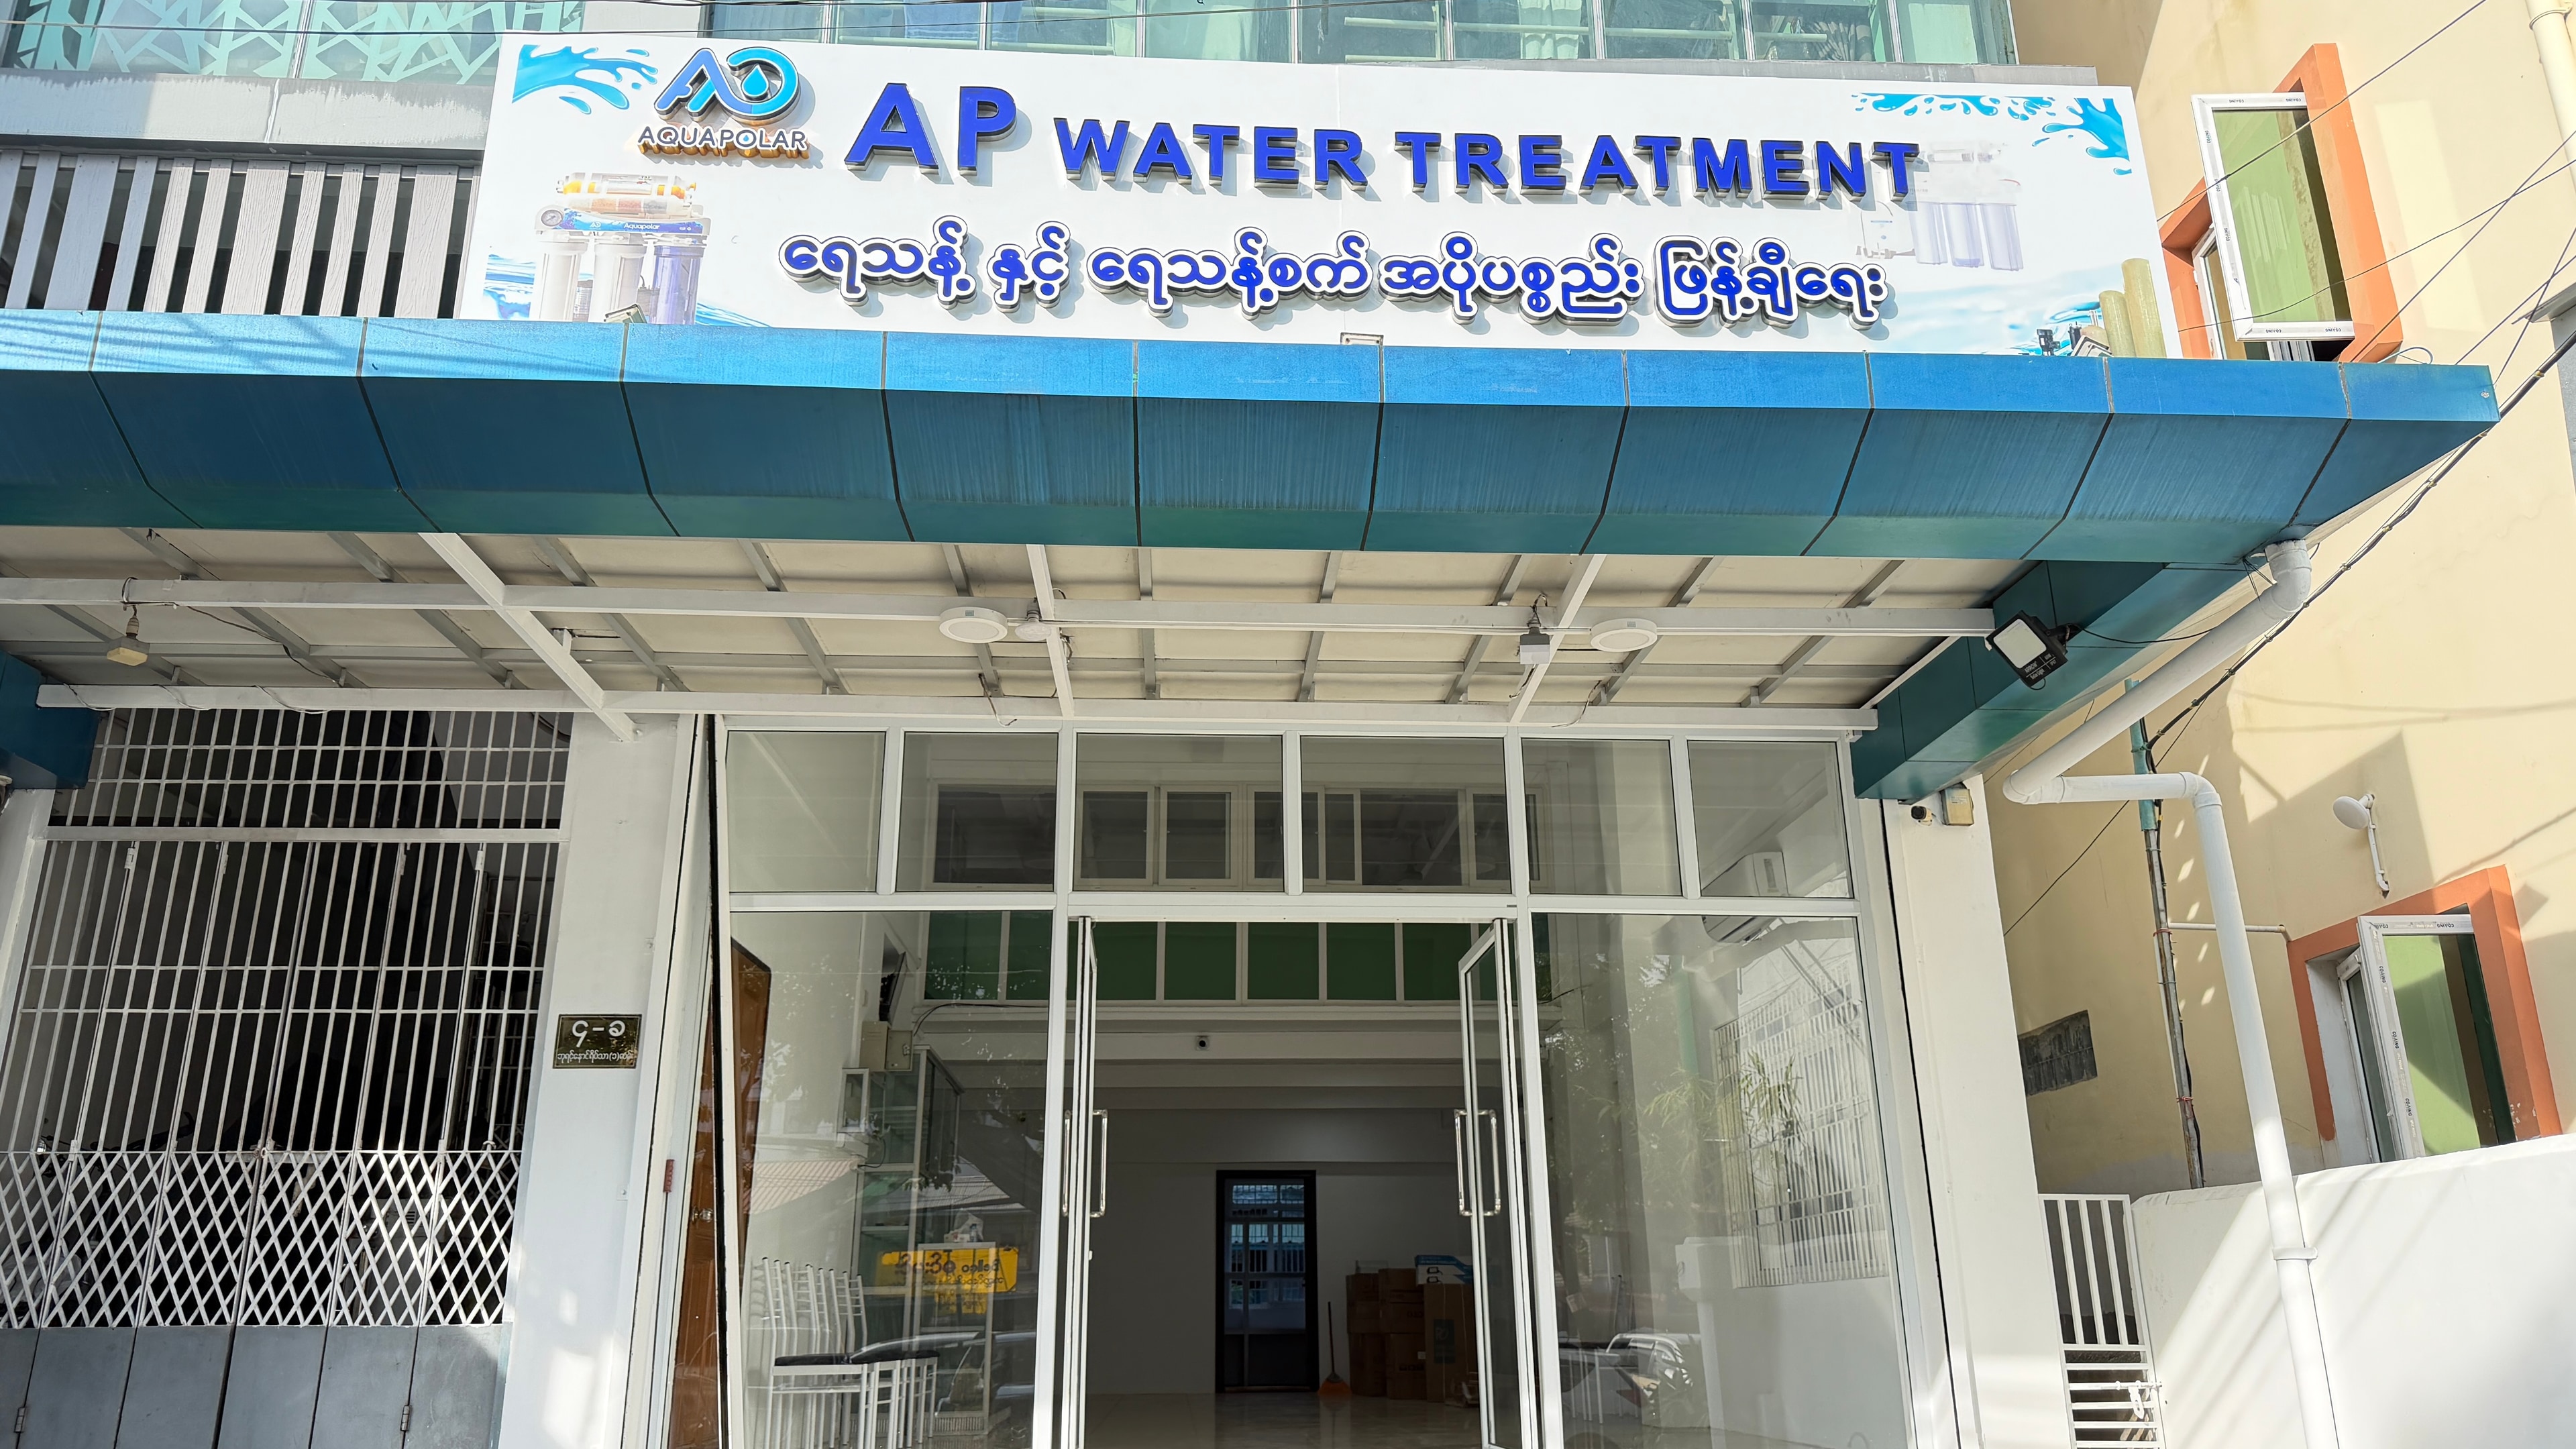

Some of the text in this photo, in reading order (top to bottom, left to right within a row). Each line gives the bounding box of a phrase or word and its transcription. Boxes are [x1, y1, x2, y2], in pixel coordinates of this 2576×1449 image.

[637, 125, 809, 152] AQUAPOLAR
[844, 82, 1920, 201] AP WATER TREATMENT
[624, 222, 661, 231] Aquapolar
